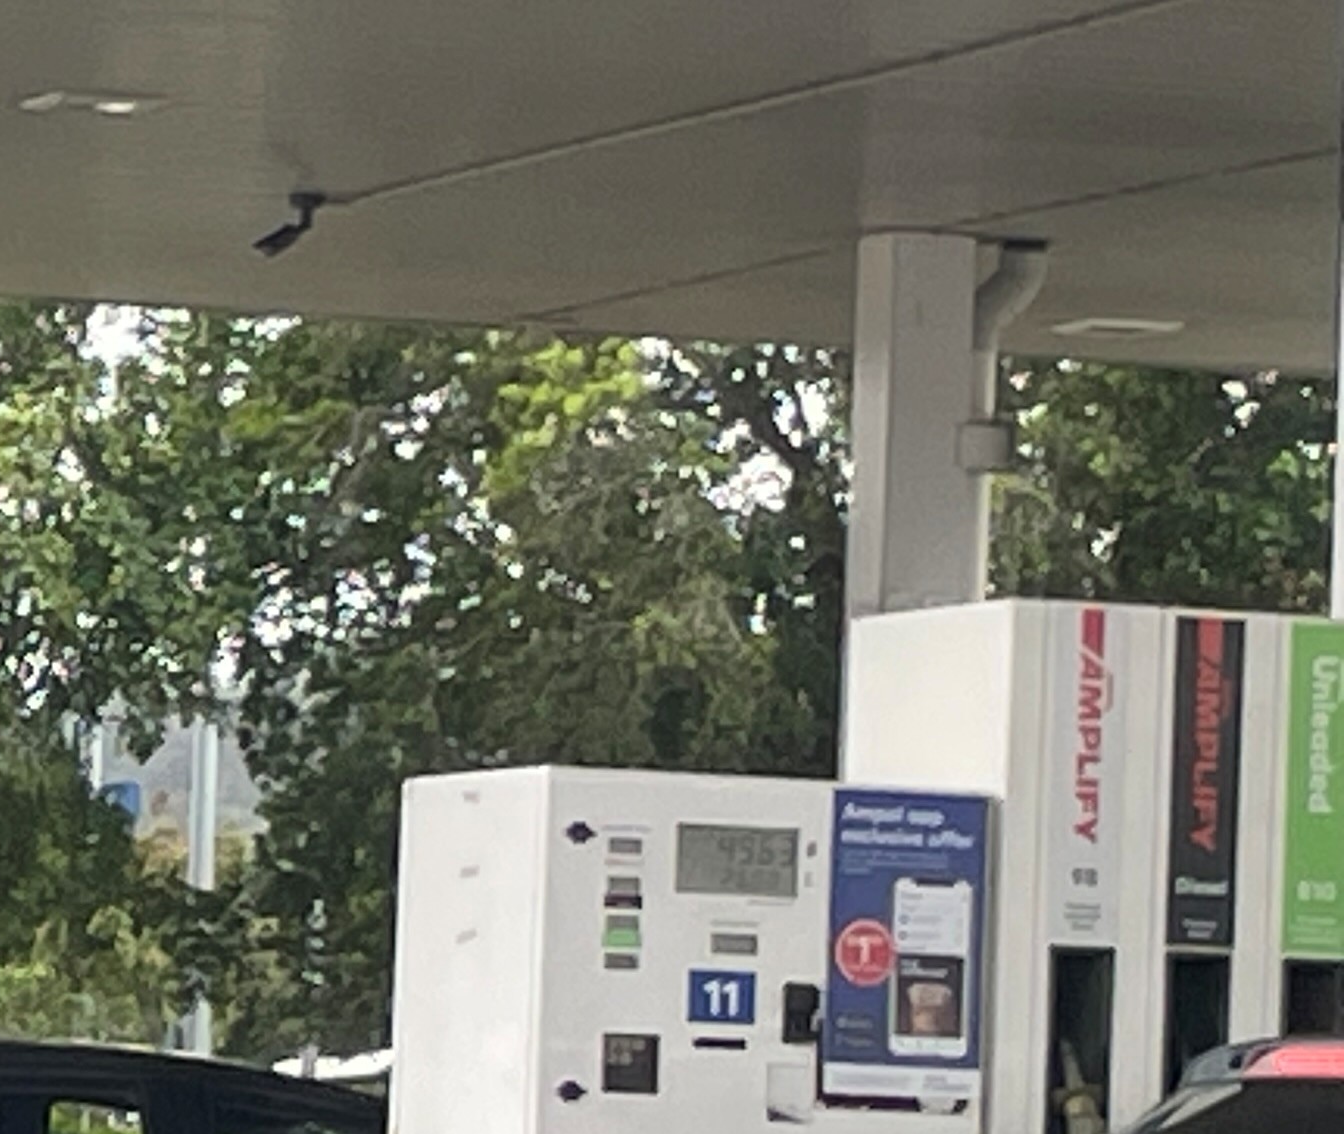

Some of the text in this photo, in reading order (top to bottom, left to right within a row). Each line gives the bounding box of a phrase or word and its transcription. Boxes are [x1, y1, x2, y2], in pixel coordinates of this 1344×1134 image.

[1074, 652, 1104, 844] AMPLIFY
[1188, 655, 1224, 853] AMPLIFY
[1307, 655, 1340, 814] Unleaded
[702, 979, 740, 1017] 11
